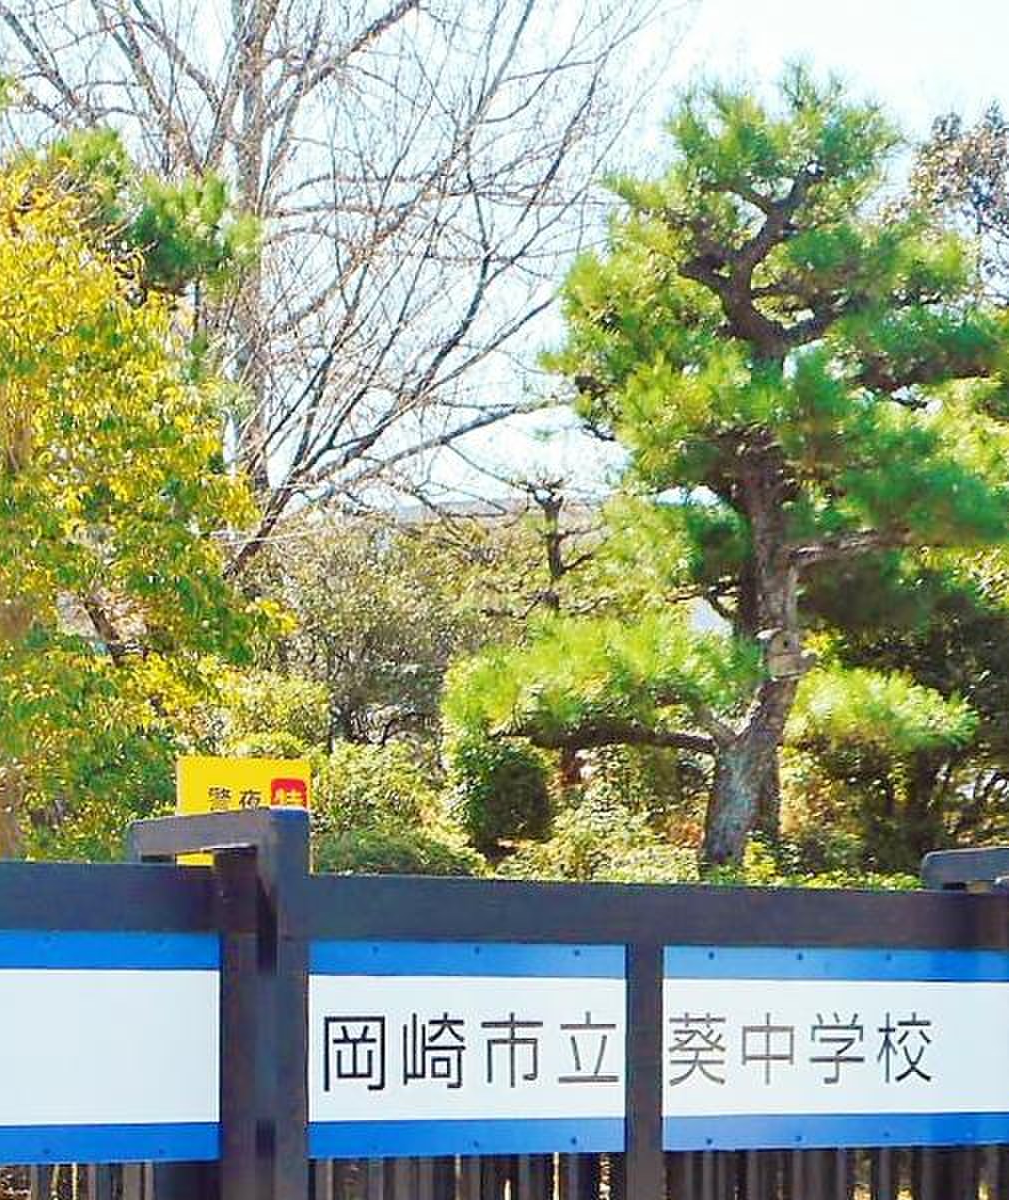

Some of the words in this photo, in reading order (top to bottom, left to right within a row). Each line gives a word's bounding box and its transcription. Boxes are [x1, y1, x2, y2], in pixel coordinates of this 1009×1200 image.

[323, 1011, 619, 1092] 岡崎市立
[668, 1011, 932, 1085] 葵中学校
